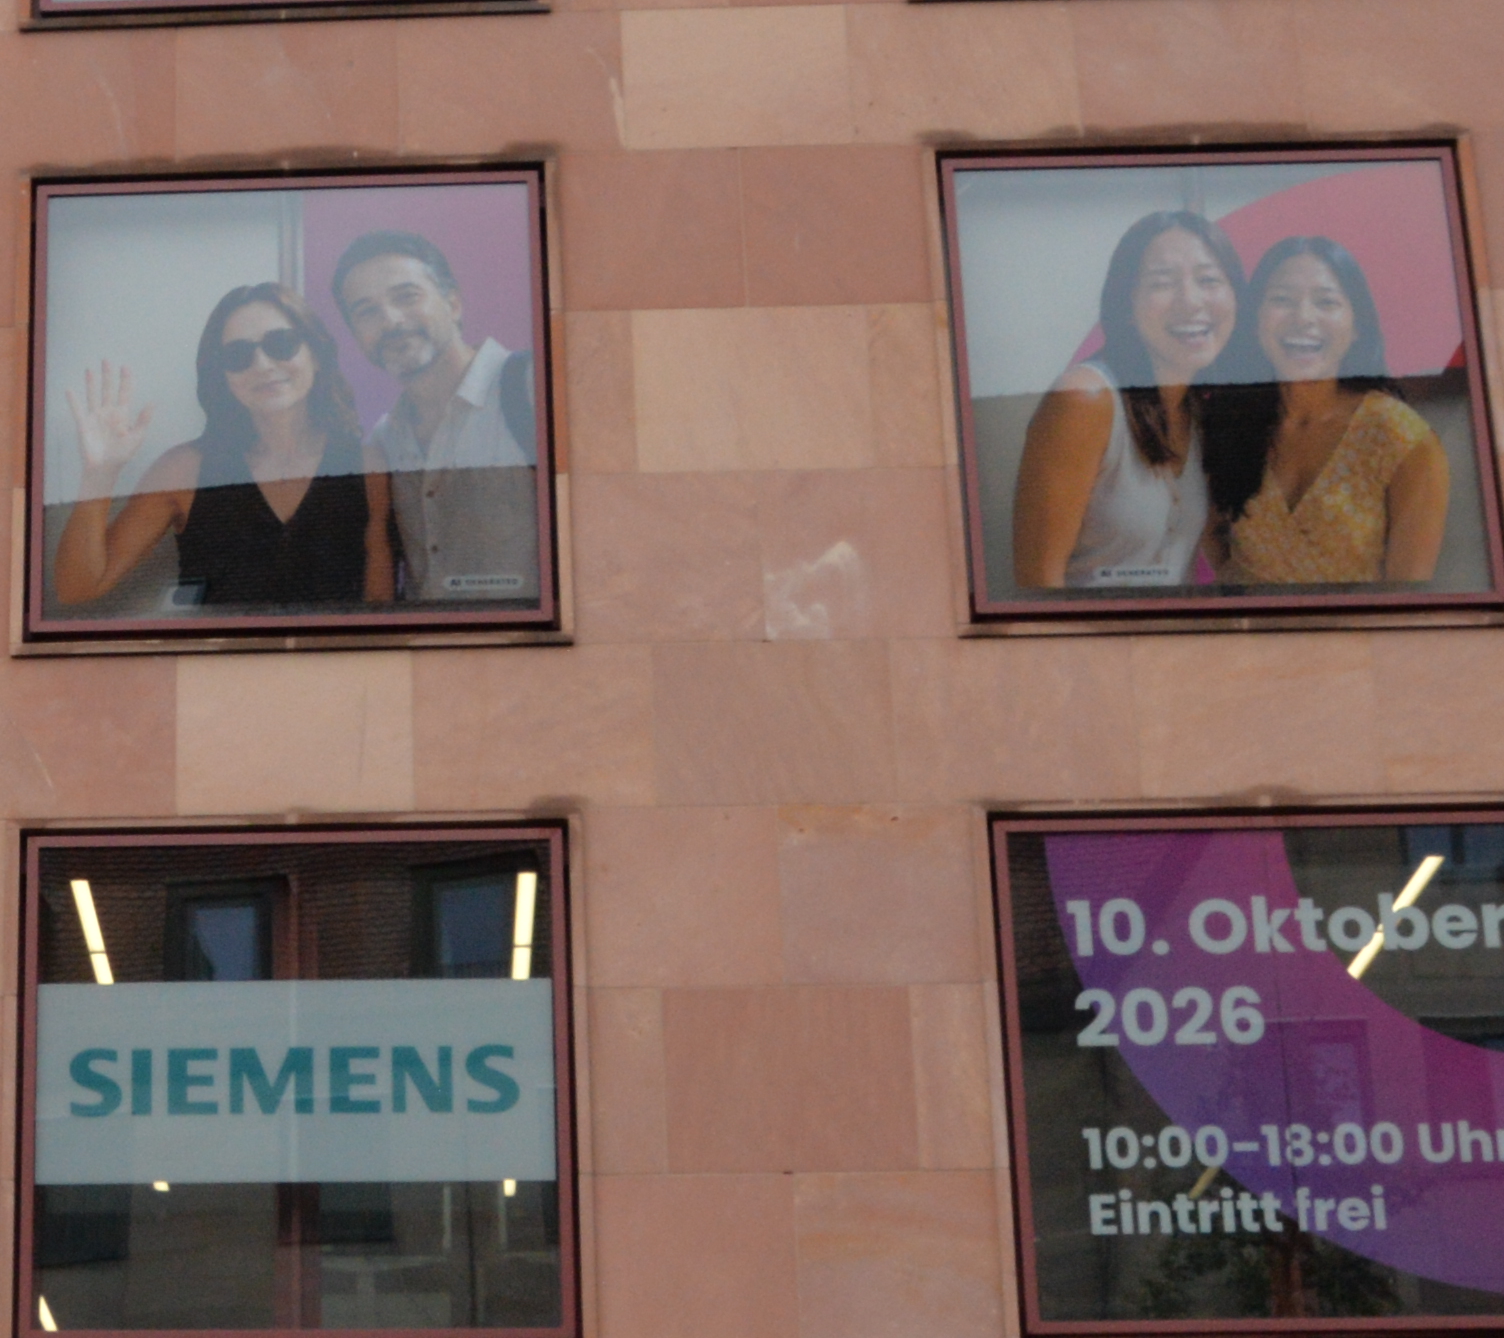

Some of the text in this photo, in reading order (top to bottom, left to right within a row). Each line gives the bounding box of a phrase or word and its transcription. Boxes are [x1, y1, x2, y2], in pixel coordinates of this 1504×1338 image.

[1067, 897, 1170, 957] 10.
[1074, 986, 1266, 1048] 2026
[68, 1043, 521, 1118] SIEMENS
[1089, 1185, 1388, 1236] Eintritt frei
